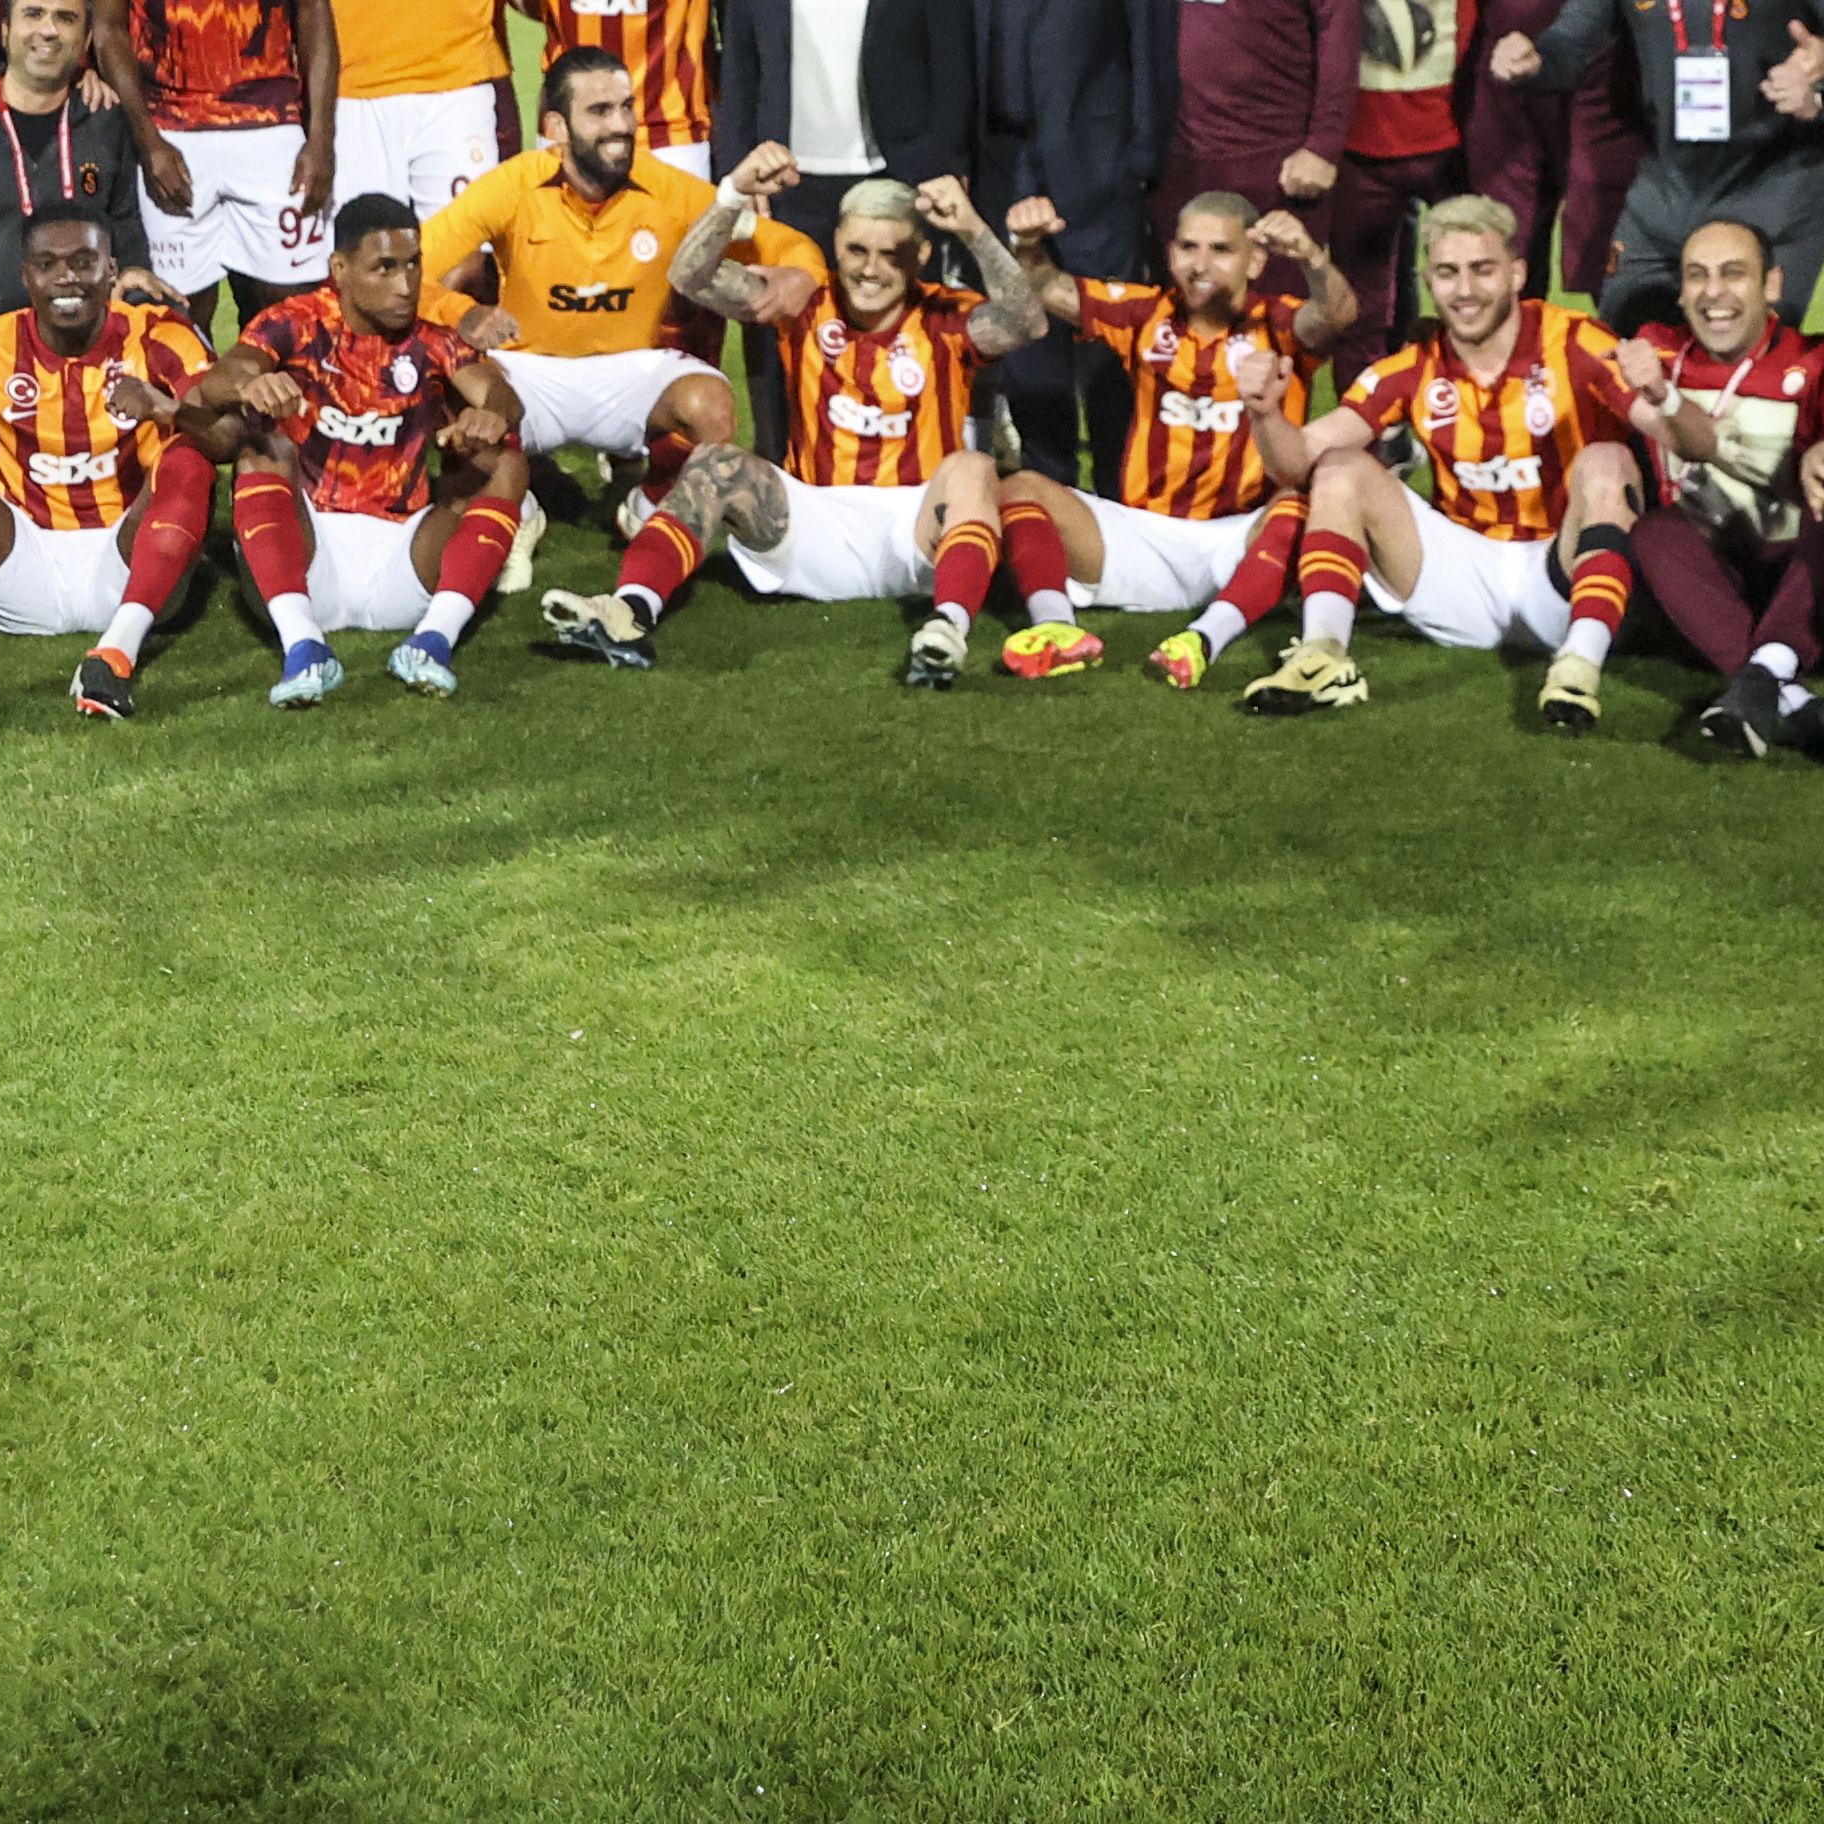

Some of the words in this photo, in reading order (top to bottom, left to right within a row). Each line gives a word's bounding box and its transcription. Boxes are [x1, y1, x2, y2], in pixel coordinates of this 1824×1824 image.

[547, 282, 635, 312] SIXT
[316, 404, 405, 447] SIXT
[827, 393, 913, 438] SIXT
[1159, 390, 1245, 433] SIXT
[28, 447, 120, 486] SIXT
[1453, 454, 1543, 492] SIXT
